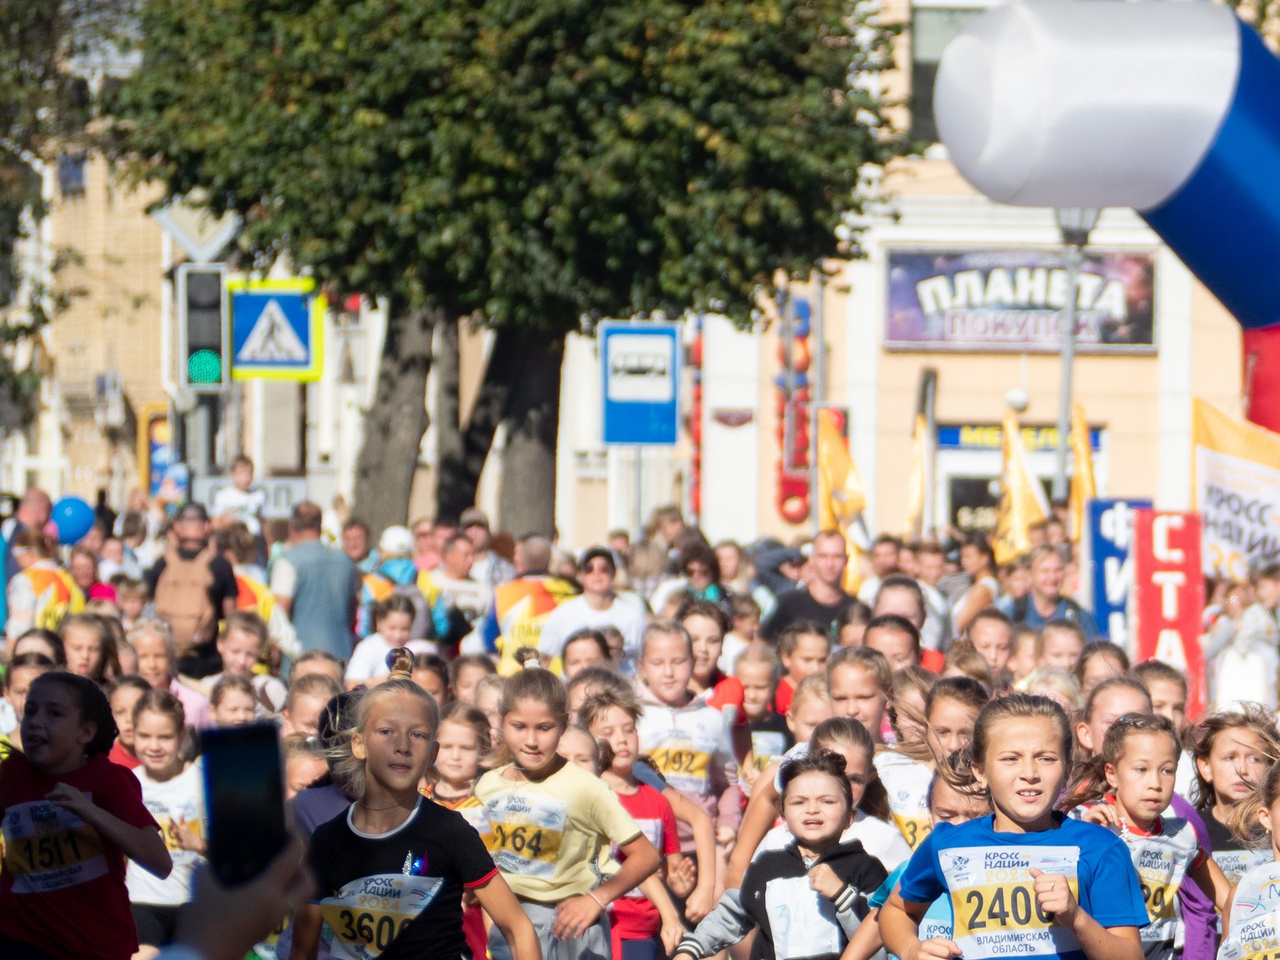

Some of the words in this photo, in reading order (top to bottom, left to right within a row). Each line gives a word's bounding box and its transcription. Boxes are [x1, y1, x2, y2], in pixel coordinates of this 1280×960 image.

[916, 267, 1127, 321] ПЛАНЕТА
[662, 750, 695, 774] 192
[24, 831, 81, 871] 1511
[985, 852, 1020, 860] КРОСС
[1141, 850, 1164, 860] КРОСС
[984, 860, 1030, 869] НАЦИИ
[1139, 859, 1171, 871] НАЦИИ
[985, 869, 1031, 882] 2024
[1240, 919, 1266, 935] КРОСС
[977, 931, 1050, 946] ВЛАДИМИРСКАЯ
[1240, 926, 1276, 944] НАЦИИ
[992, 943, 1035, 954] ОБЛАСТЬ
[1243, 938, 1279, 955] 2024
